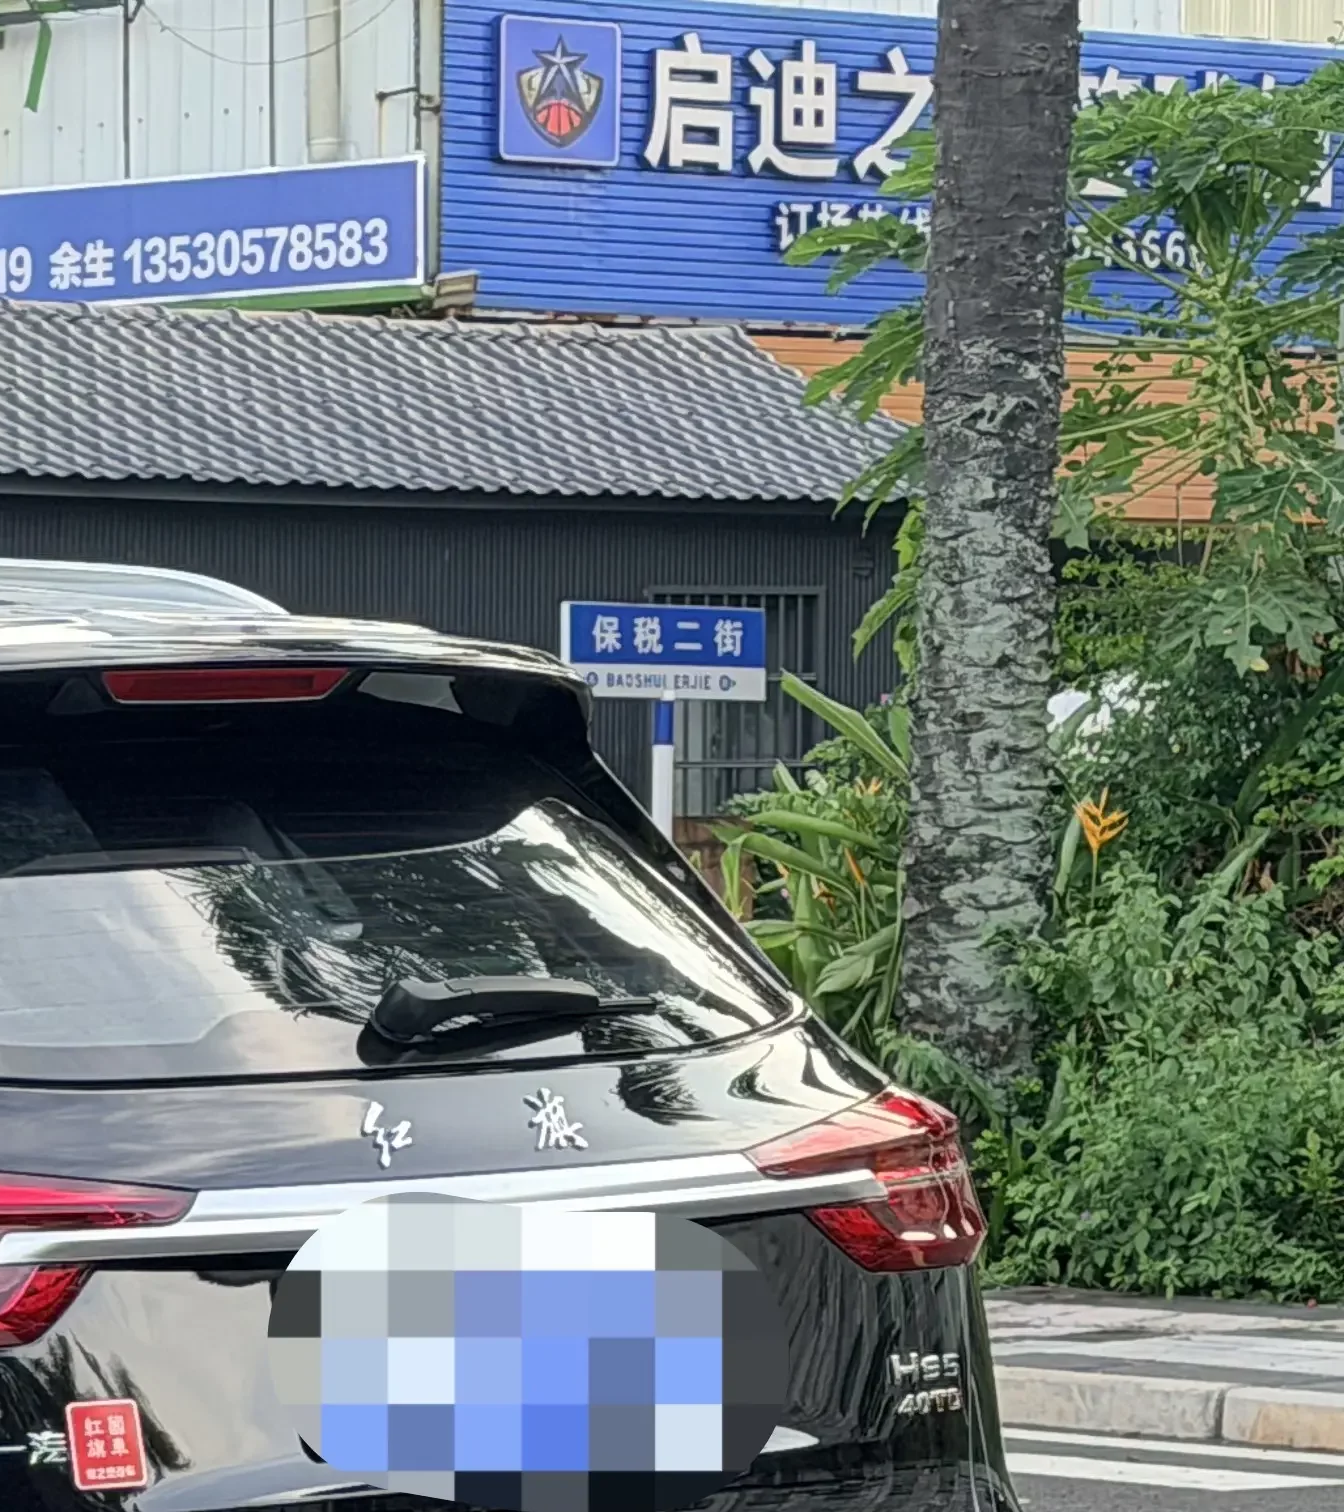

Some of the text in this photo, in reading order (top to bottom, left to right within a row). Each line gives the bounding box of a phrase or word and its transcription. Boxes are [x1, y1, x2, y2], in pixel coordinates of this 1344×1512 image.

[48, 239, 116, 290] 余生
[123, 217, 389, 284] 13530578583
[592, 614, 744, 657] 保税二街
[606, 673, 667, 689] BAOSHUI
[673, 675, 712, 690] ERJIE
[890, 1351, 961, 1385] HS5
